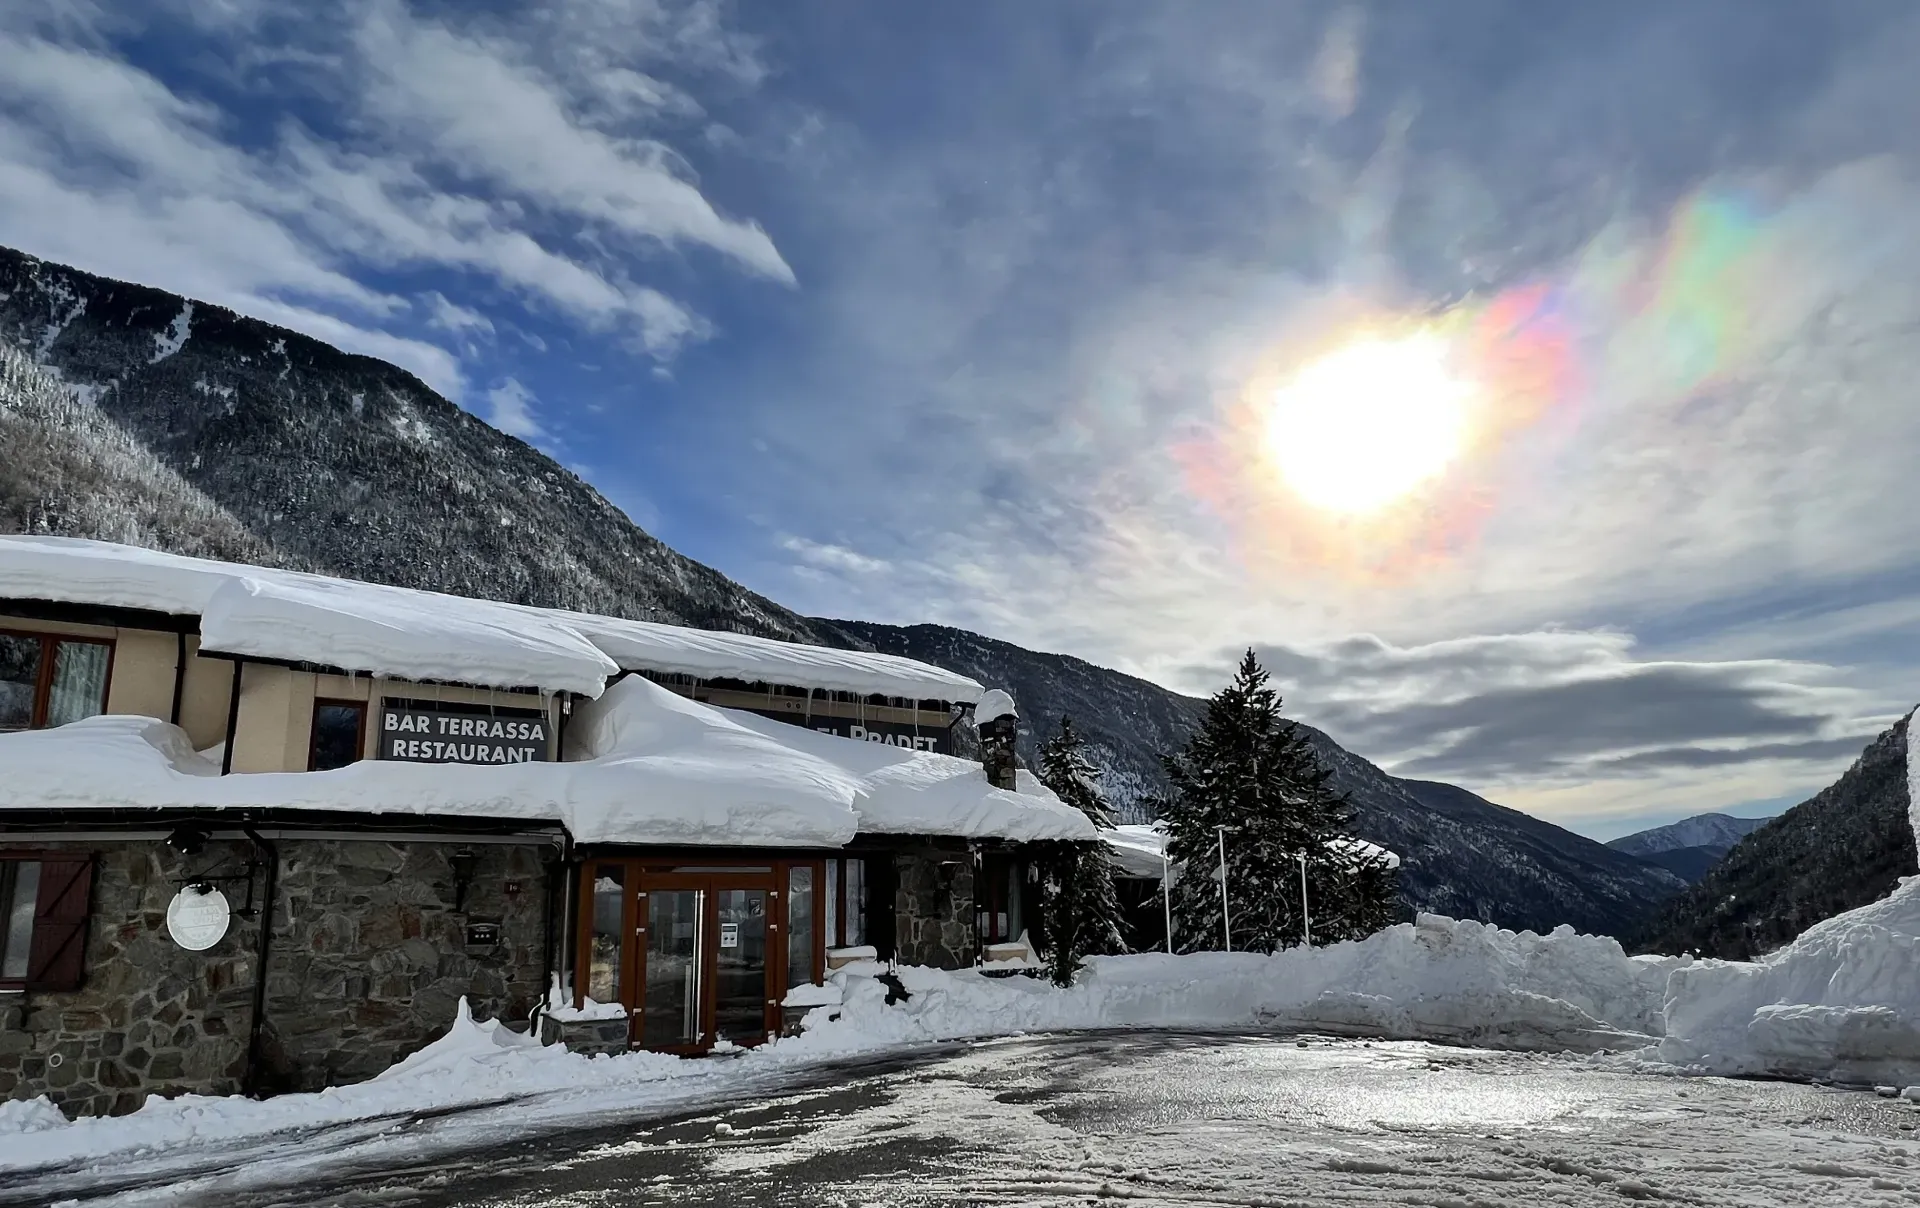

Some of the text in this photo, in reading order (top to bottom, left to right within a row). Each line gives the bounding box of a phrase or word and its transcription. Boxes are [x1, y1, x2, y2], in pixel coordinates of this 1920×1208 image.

[384, 713, 545, 741] BAR TERRASSA
[392, 739, 536, 763] RESTAURANT
